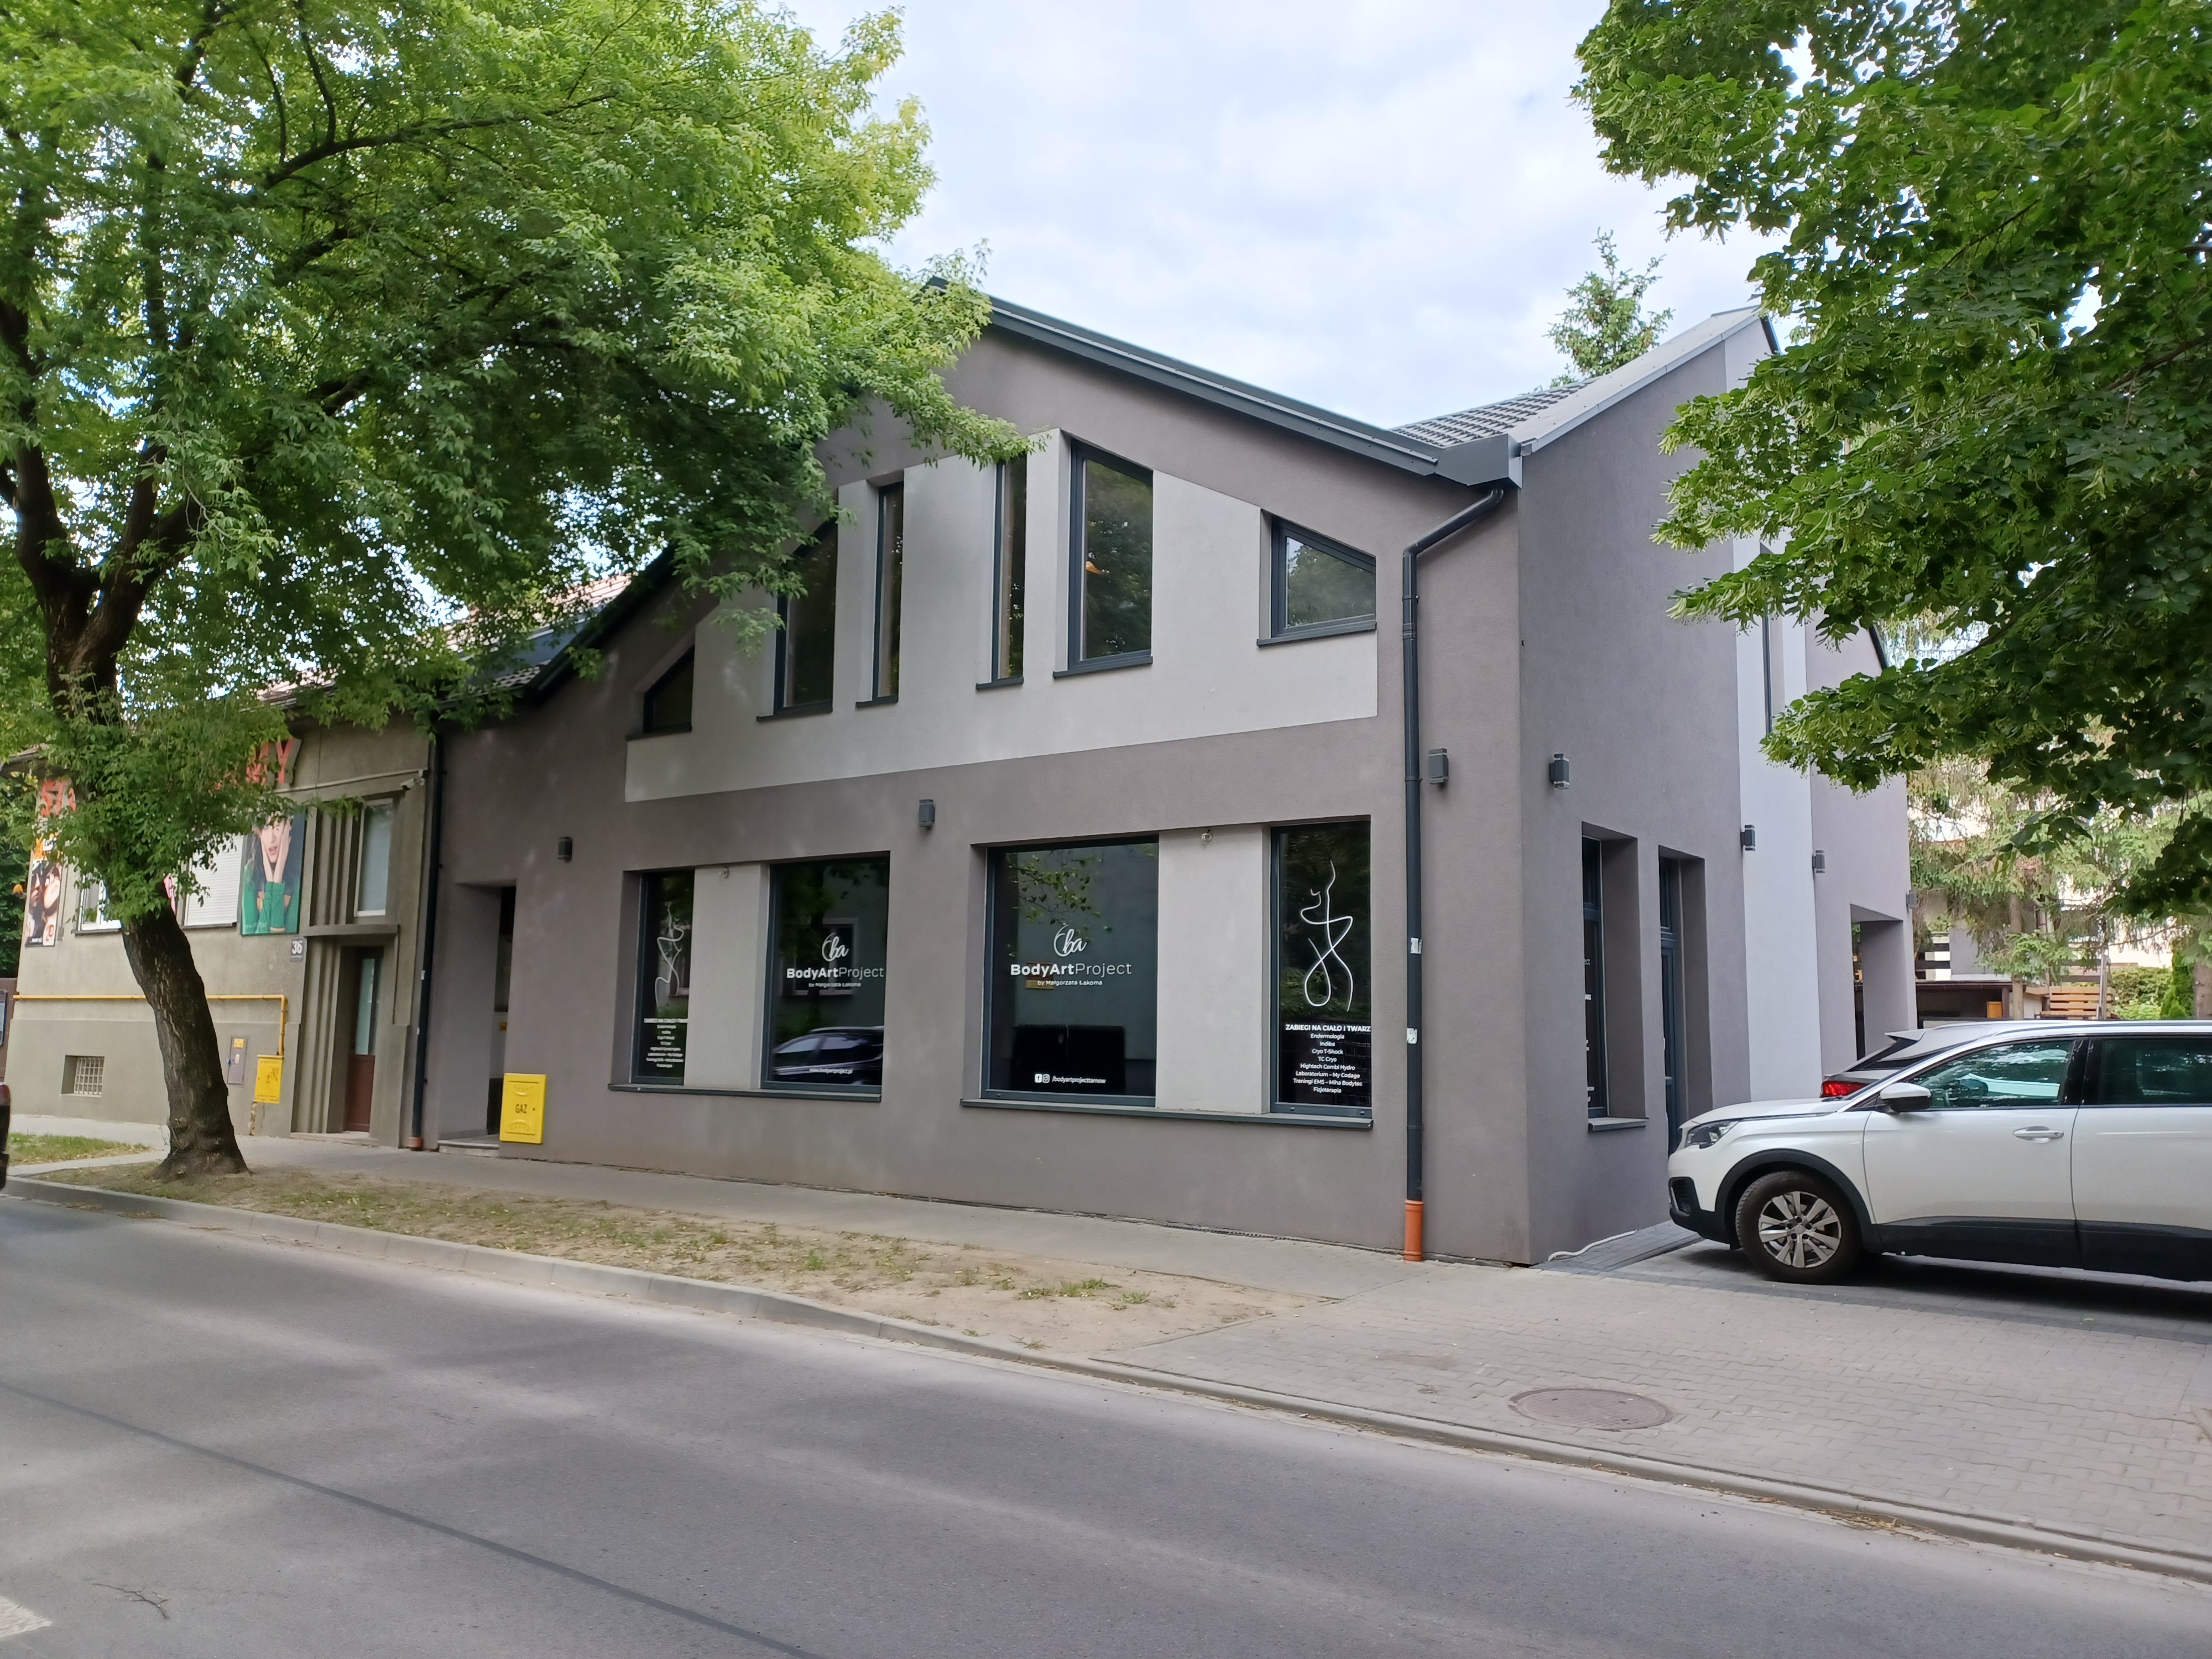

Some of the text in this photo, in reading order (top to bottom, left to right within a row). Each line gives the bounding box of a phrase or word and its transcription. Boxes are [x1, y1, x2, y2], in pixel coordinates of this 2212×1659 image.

[291, 940, 303, 954] 36
[786, 967, 884, 980] BodyArtProject
[1010, 963, 1132, 978] BodyArtProject
[515, 1104, 527, 1114] GAZ
